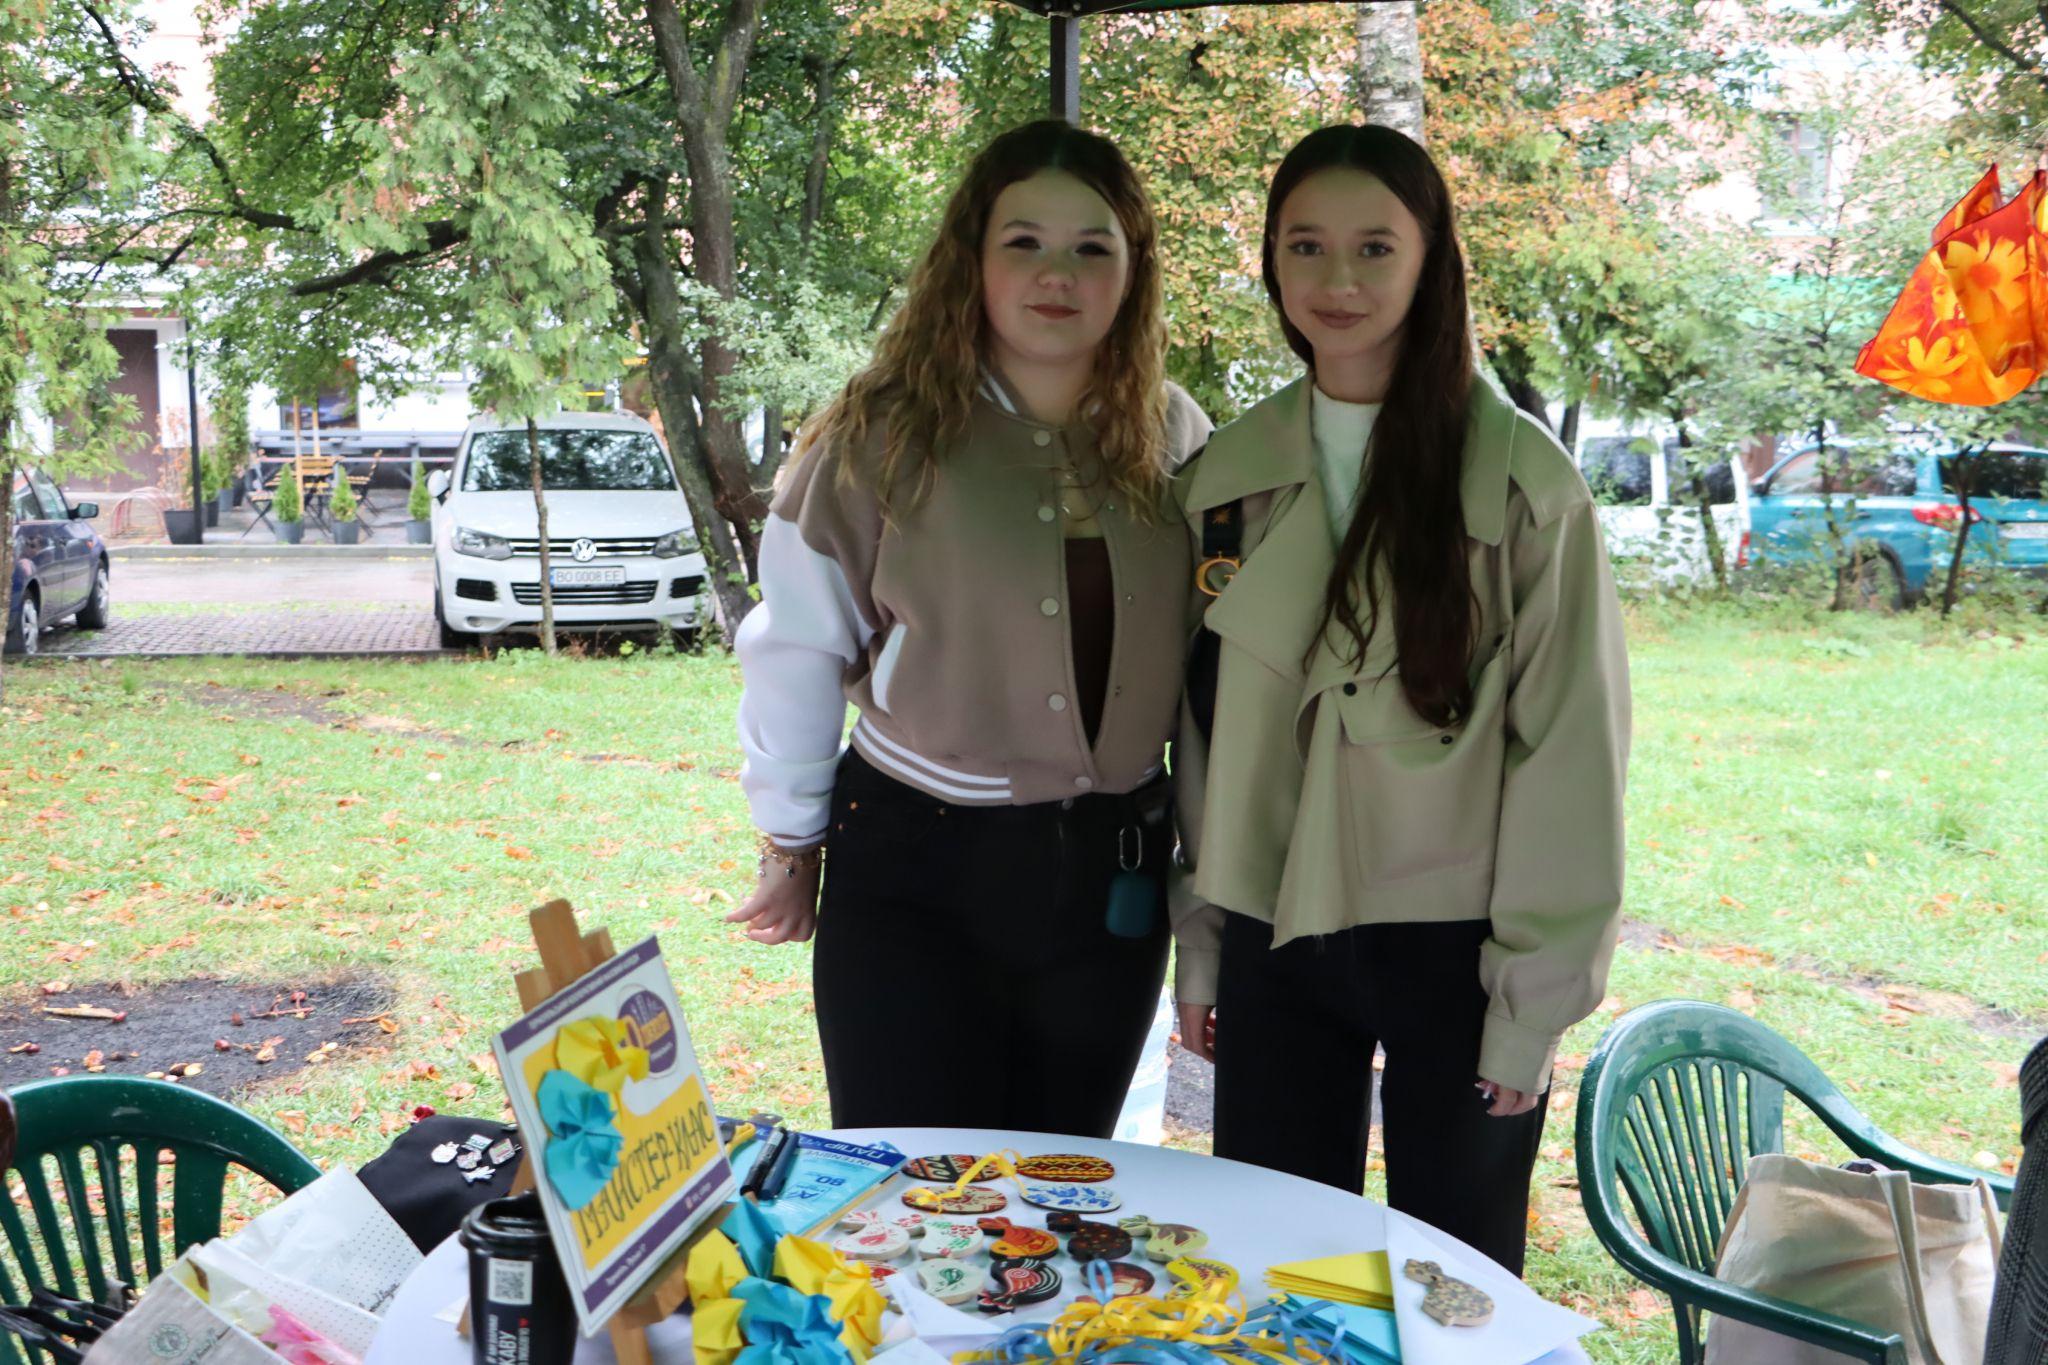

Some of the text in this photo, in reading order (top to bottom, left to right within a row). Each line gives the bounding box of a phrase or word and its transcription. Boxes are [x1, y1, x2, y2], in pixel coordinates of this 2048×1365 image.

[604, 569, 621, 582] EE
[824, 1143, 885, 1159] ПАПІР
[815, 1175, 846, 1187] 80
